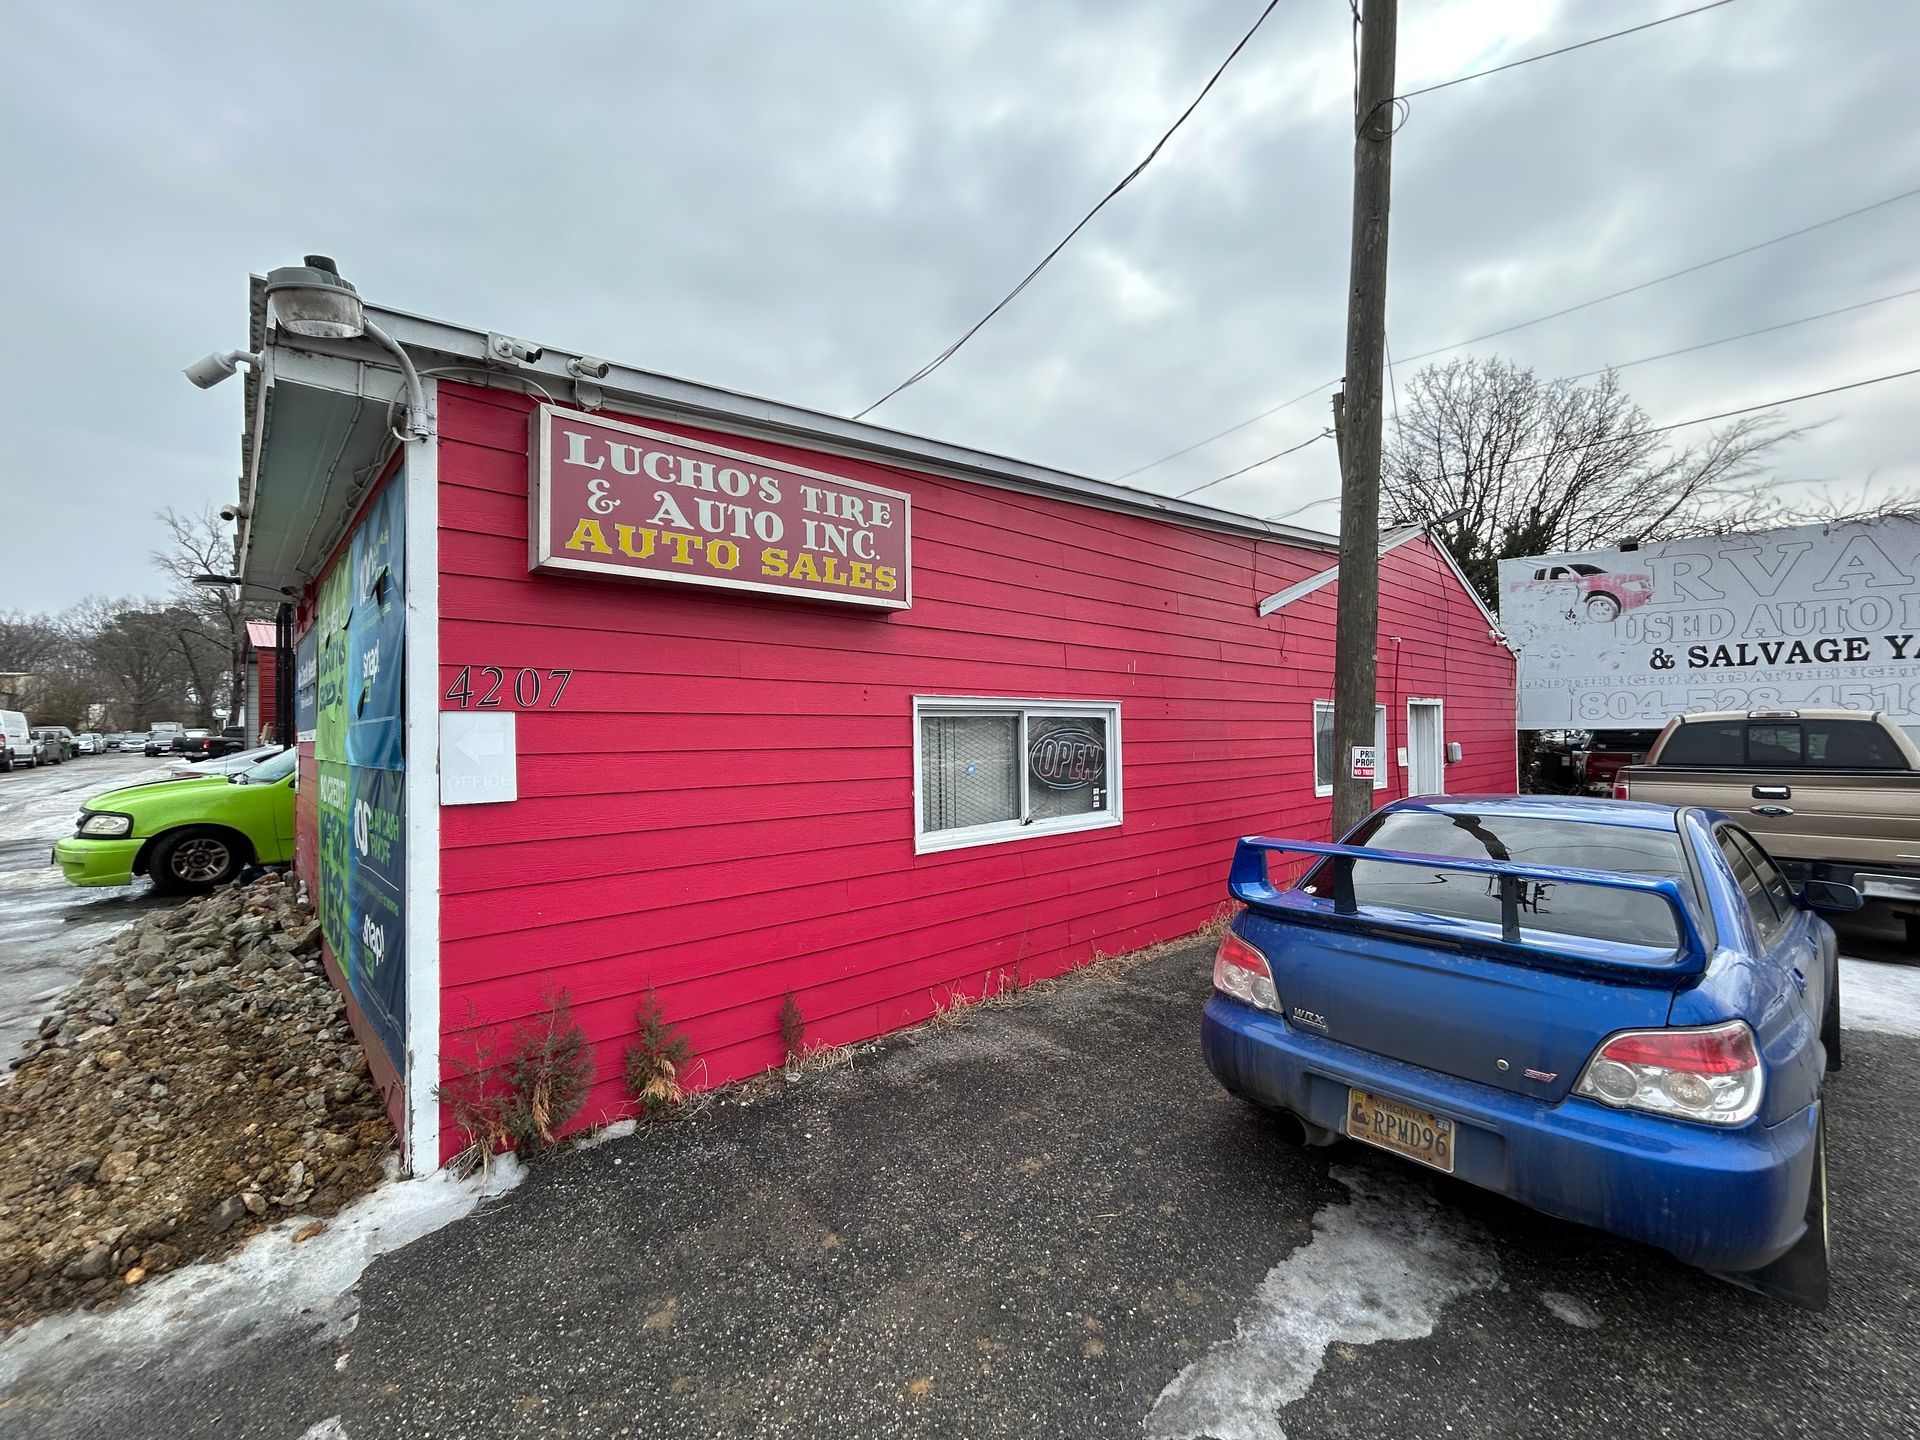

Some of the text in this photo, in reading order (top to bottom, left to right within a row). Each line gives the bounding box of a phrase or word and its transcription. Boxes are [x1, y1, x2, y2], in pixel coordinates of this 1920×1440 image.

[563, 431, 893, 529] LUCHO'S TIRE
[586, 478, 881, 560] & AUTO INC.
[564, 518, 897, 592] AUTO SALES
[1615, 606, 1736, 645] USED
[1742, 596, 1893, 639] AUTO
[1650, 647, 1675, 670] &
[1688, 637, 1870, 669] SALVAGE
[445, 665, 573, 708] 4207
[1039, 739, 1099, 781] OPEN
[1294, 1007, 1325, 1025] WRX
[1374, 1109, 1447, 1157] RPMD96
[1375, 1100, 1425, 1122] VIRGINIA
